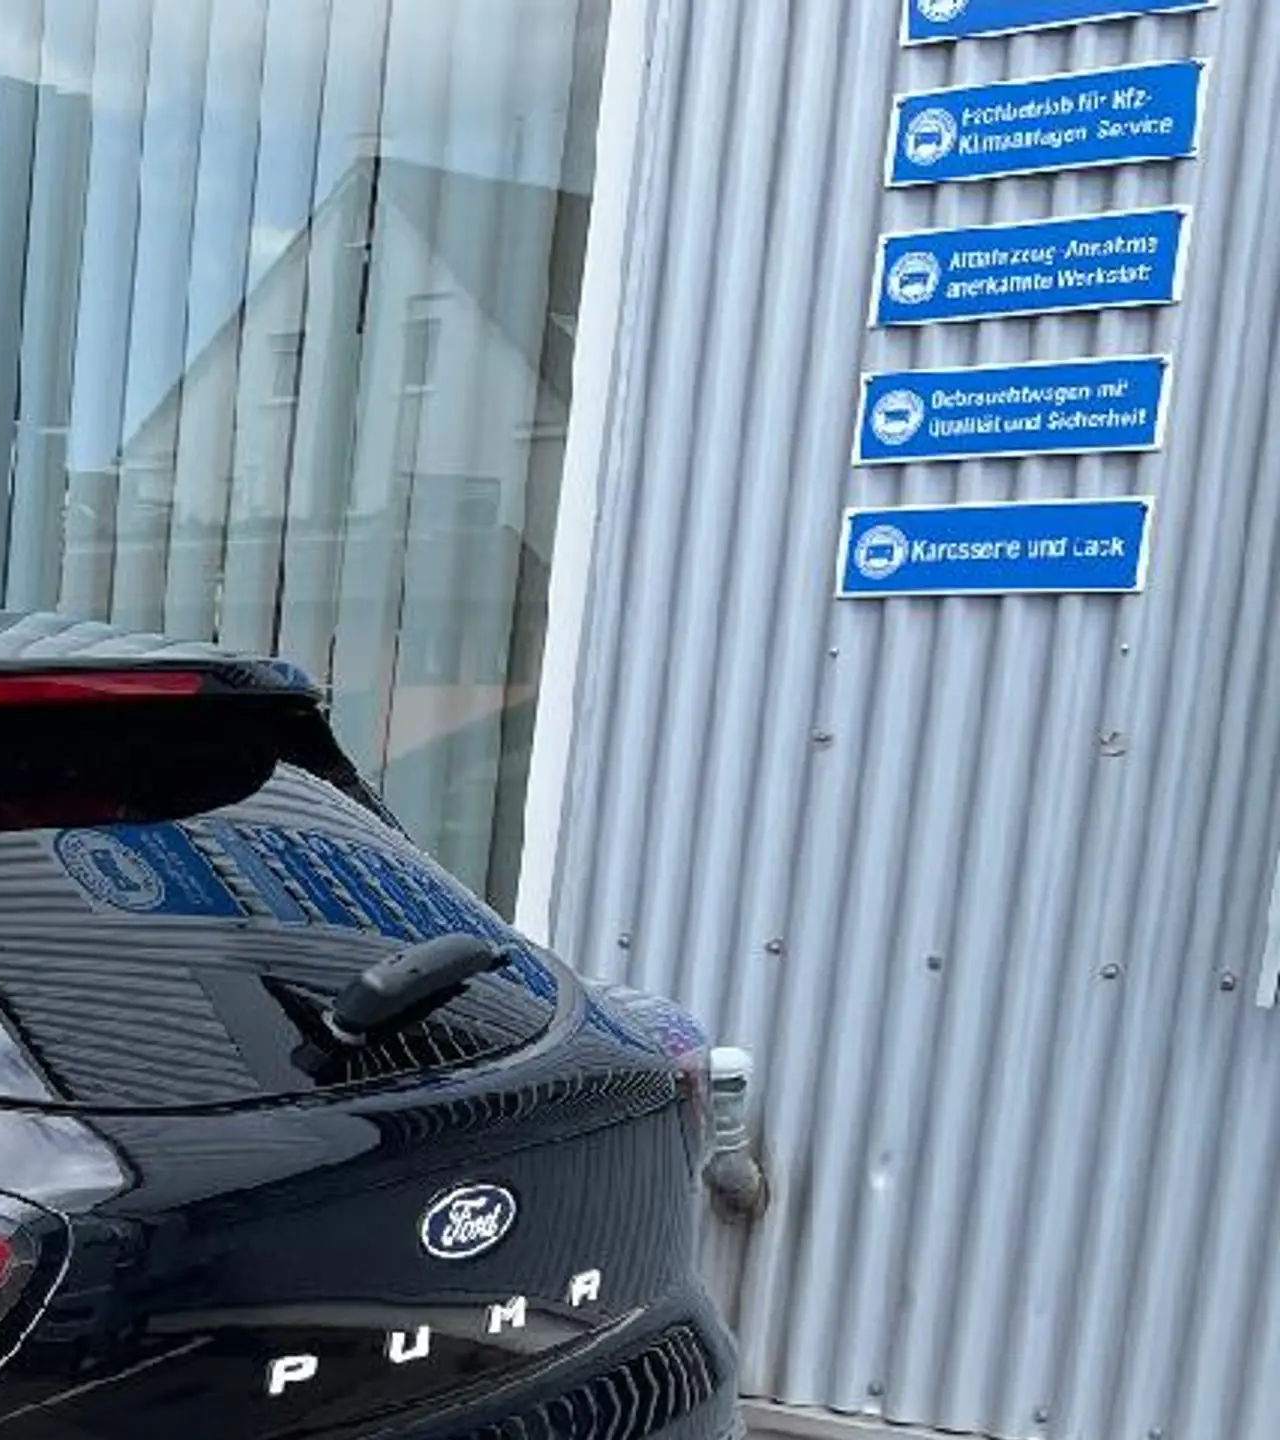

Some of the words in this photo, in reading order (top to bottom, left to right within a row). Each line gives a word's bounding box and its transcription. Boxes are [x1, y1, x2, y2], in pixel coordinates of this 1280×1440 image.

[1096, 116, 1175, 141] Service
[1003, 413, 1041, 432] und
[1027, 536, 1069, 560] und
[440, 1196, 502, 1247] Ford
[265, 1268, 602, 1396] PUMA
